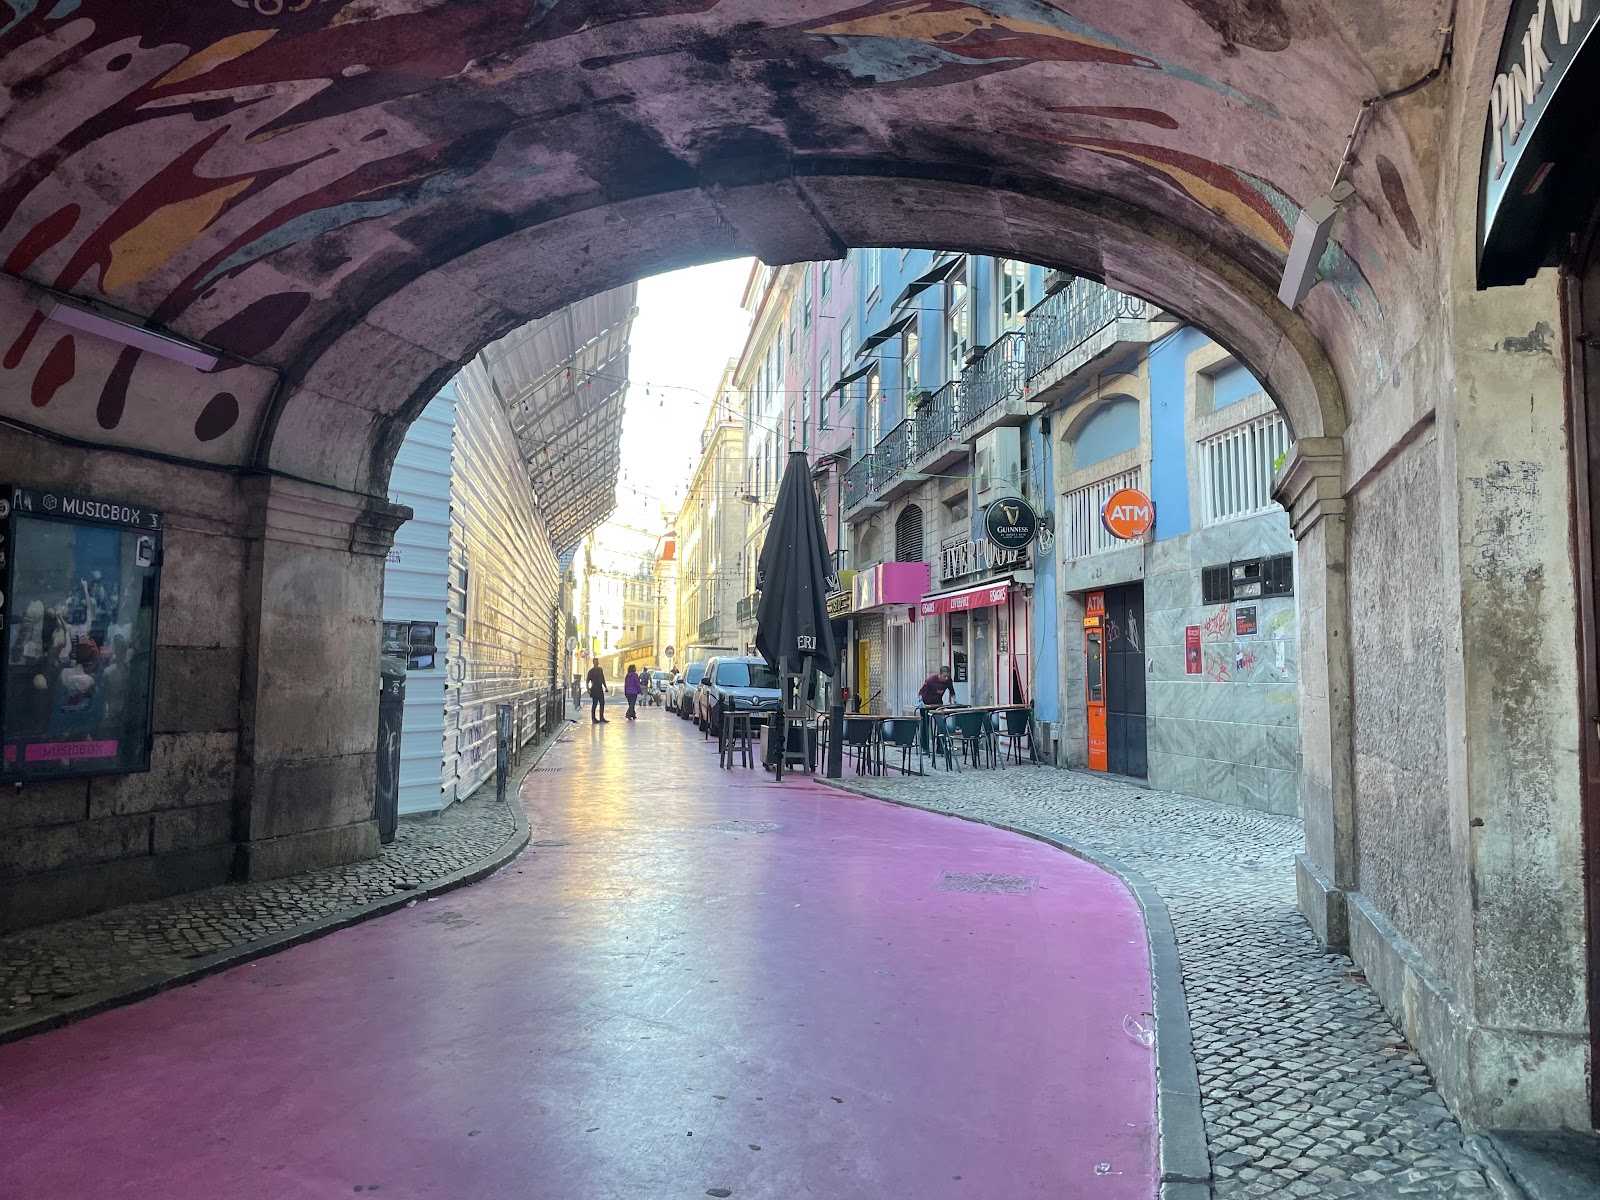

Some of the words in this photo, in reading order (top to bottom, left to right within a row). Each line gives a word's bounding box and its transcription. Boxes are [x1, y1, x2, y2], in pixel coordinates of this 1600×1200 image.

[1490, 0, 1554, 180] PINK
[62, 497, 140, 525] MUSICBOX
[1110, 505, 1149, 521] ATM
[997, 526, 1029, 534] GUINNESS
[1087, 596, 1104, 611] ATM
[42, 743, 104, 757] MUSICBOX
